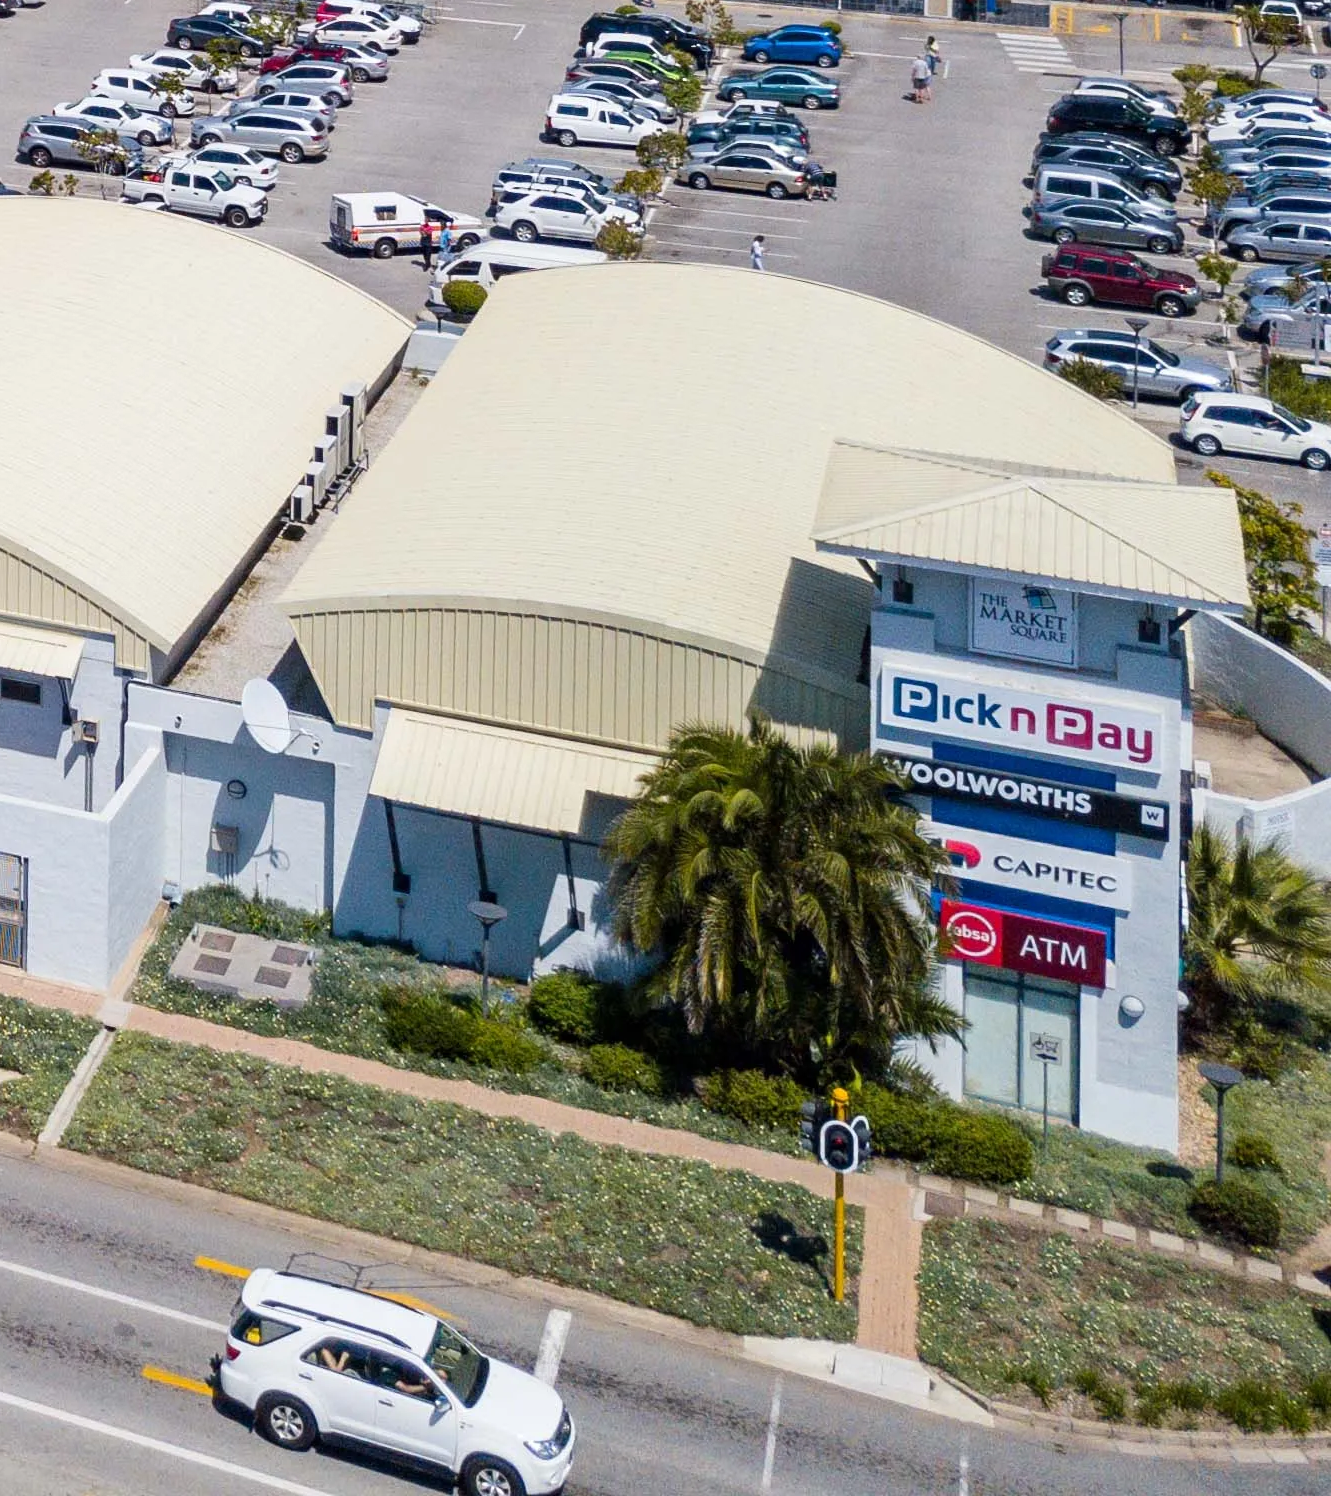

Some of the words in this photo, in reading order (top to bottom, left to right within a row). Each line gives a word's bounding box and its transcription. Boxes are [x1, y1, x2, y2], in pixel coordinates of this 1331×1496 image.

[979, 592, 1008, 608] THE
[979, 605, 1068, 631] MARKET
[1010, 624, 1068, 644] SQUARE
[893, 676, 1002, 729] Pick
[1010, 706, 1036, 735] n
[1046, 703, 1153, 764] Pay
[993, 855, 1117, 892] CAPITEC
[953, 923, 991, 942] absa
[1019, 934, 1088, 970] ATM
